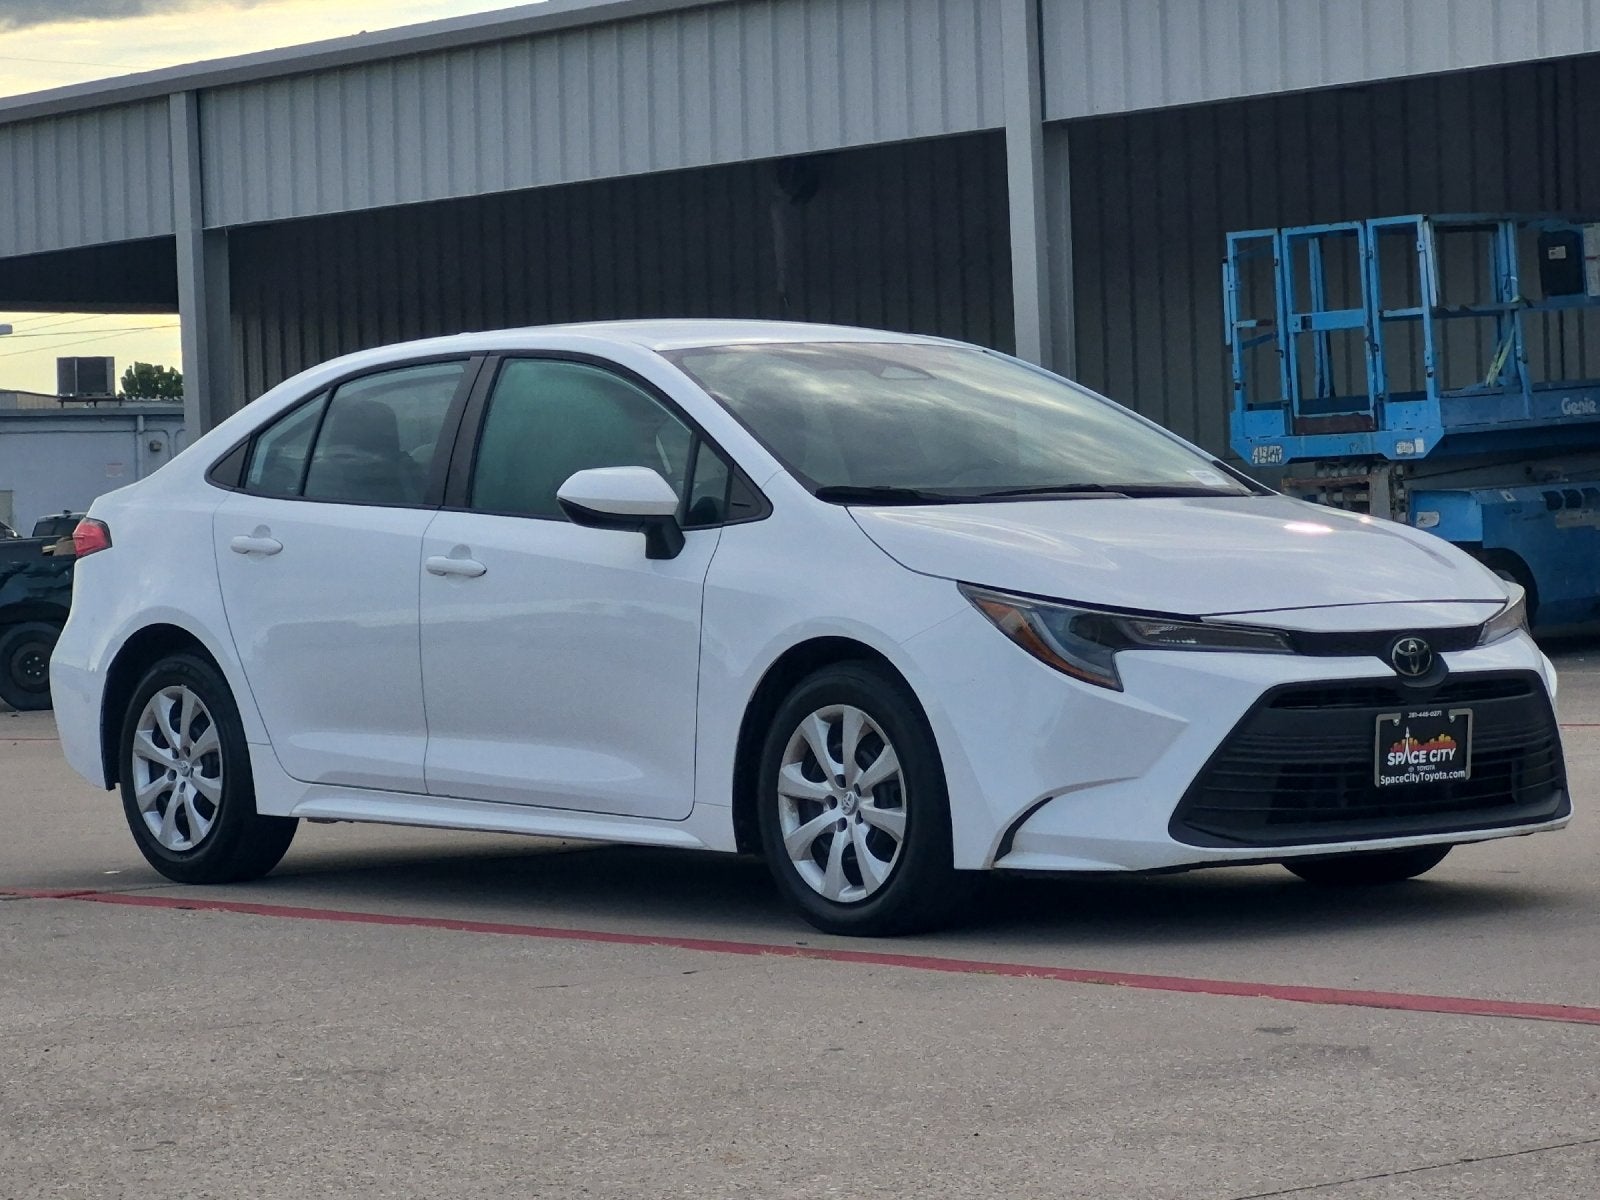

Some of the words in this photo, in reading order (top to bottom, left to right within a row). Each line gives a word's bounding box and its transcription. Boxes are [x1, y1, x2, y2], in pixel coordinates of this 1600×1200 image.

[1561, 397, 1597, 415] Genie
[1387, 749, 1427, 766] SPACE
[1429, 748, 1456, 762] CITY
[1380, 770, 1466, 786] SpaceCityToyota.com
